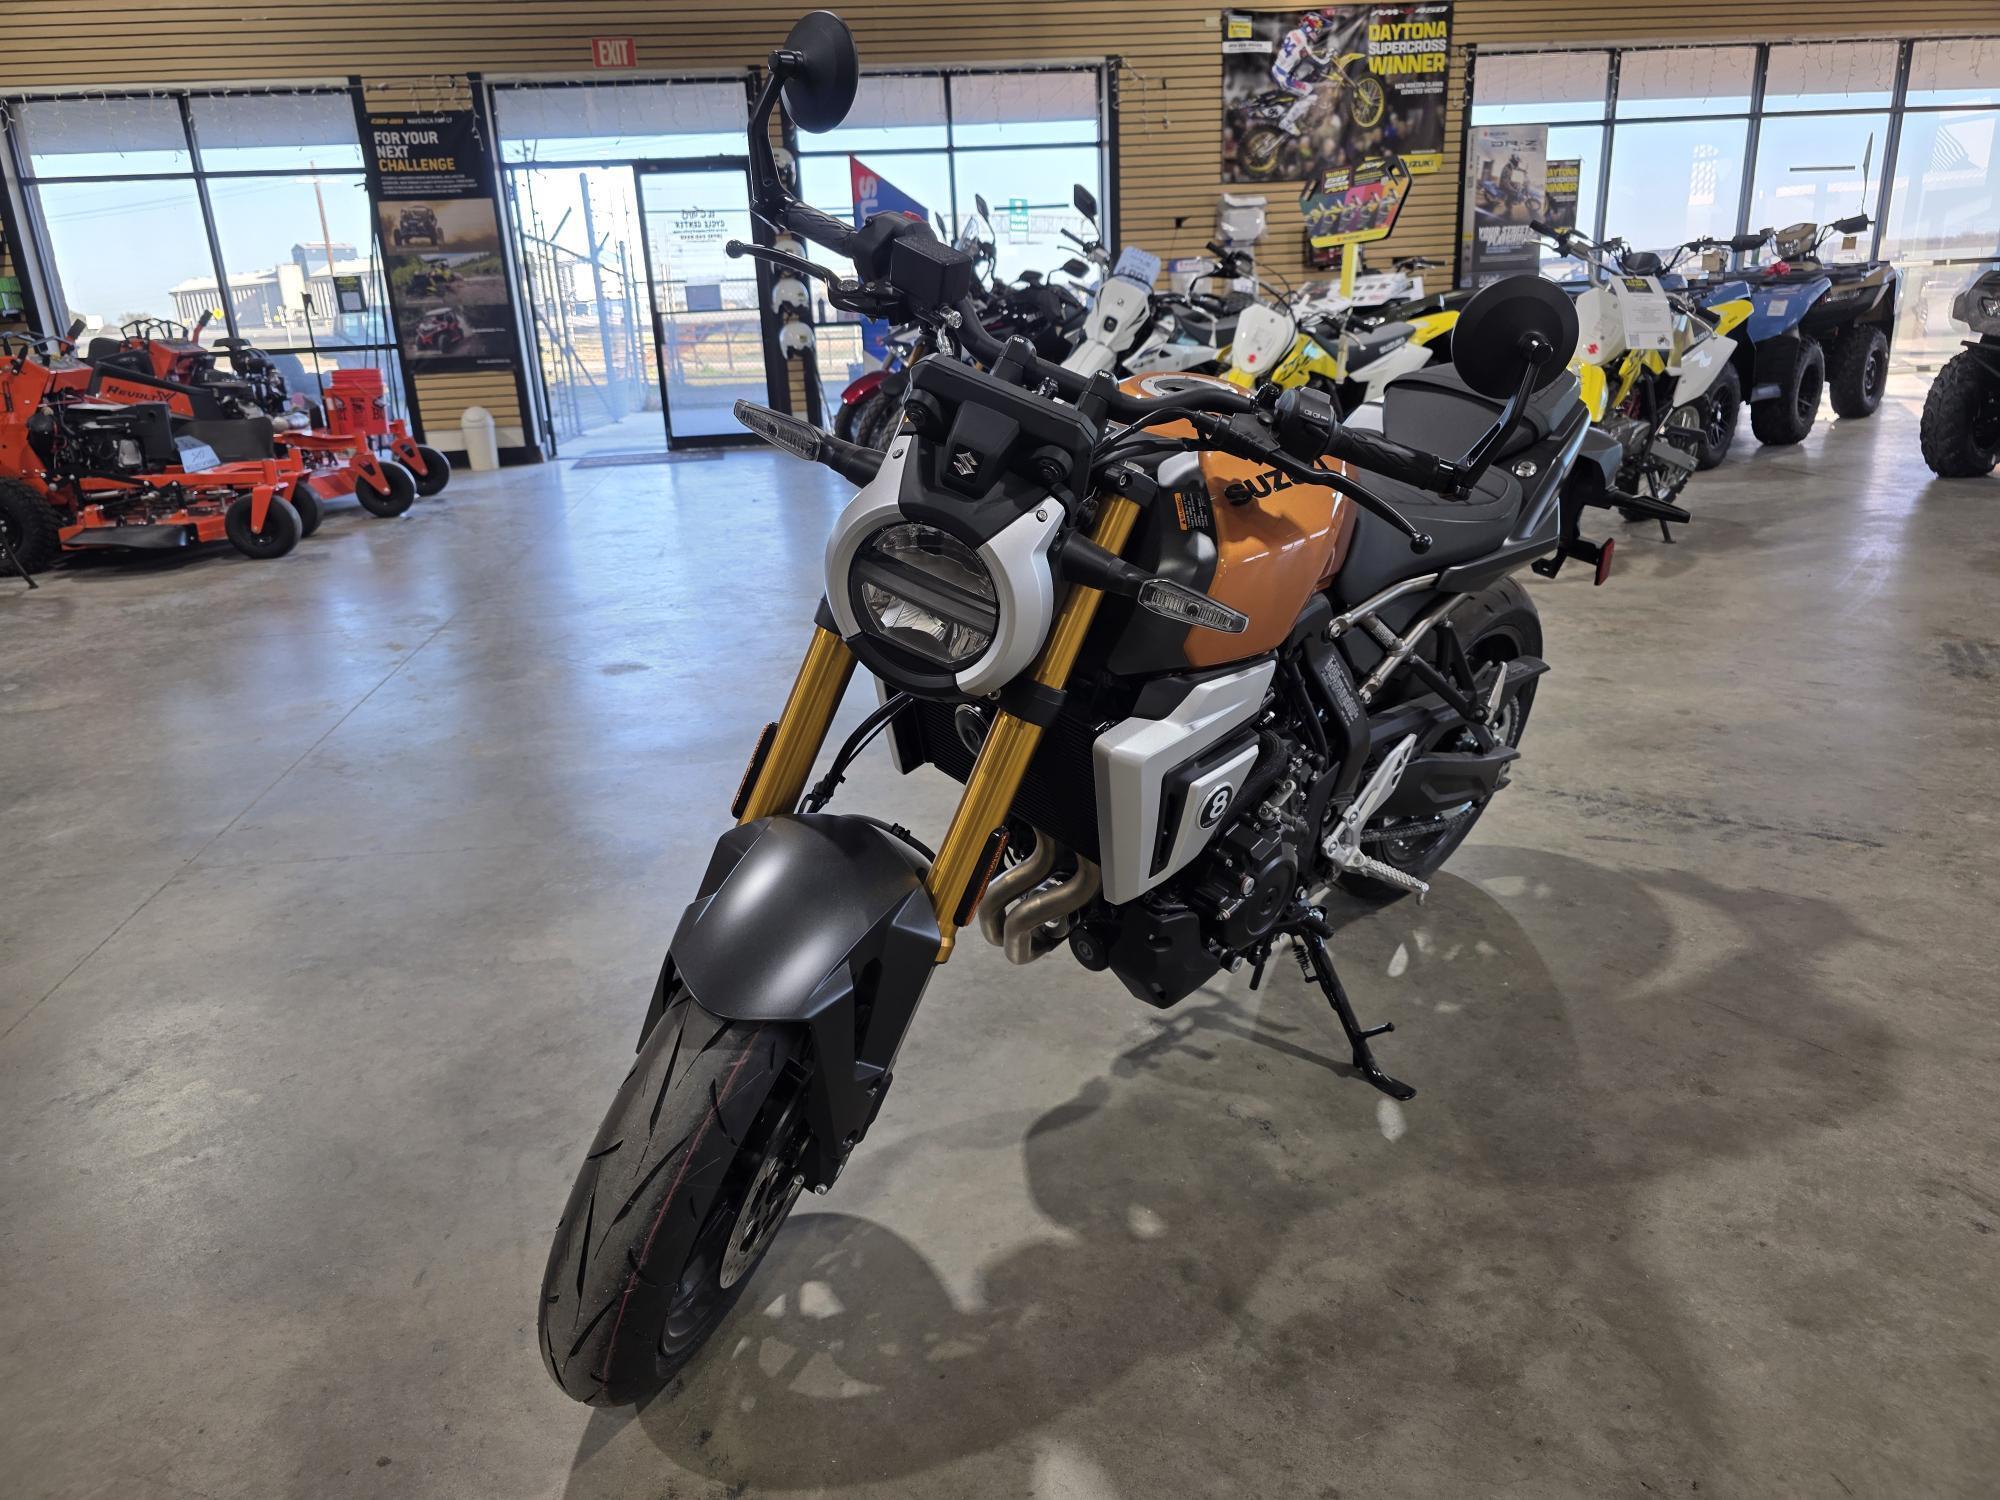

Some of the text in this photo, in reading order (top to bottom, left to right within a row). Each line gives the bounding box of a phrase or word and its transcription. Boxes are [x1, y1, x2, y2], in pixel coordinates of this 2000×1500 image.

[1368, 21, 1448, 41] DAYTONA
[597, 40, 628, 66] EXIT
[1368, 39, 1447, 55] SUPERCROSS
[1368, 53, 1446, 75] WINNER
[373, 130, 439, 145] FOR YOUR
[376, 145, 409, 159] NEXT
[378, 157, 456, 172] CHALLENGE
[1405, 160, 1434, 168] UZUKI
[1209, 790, 1229, 819] 8
